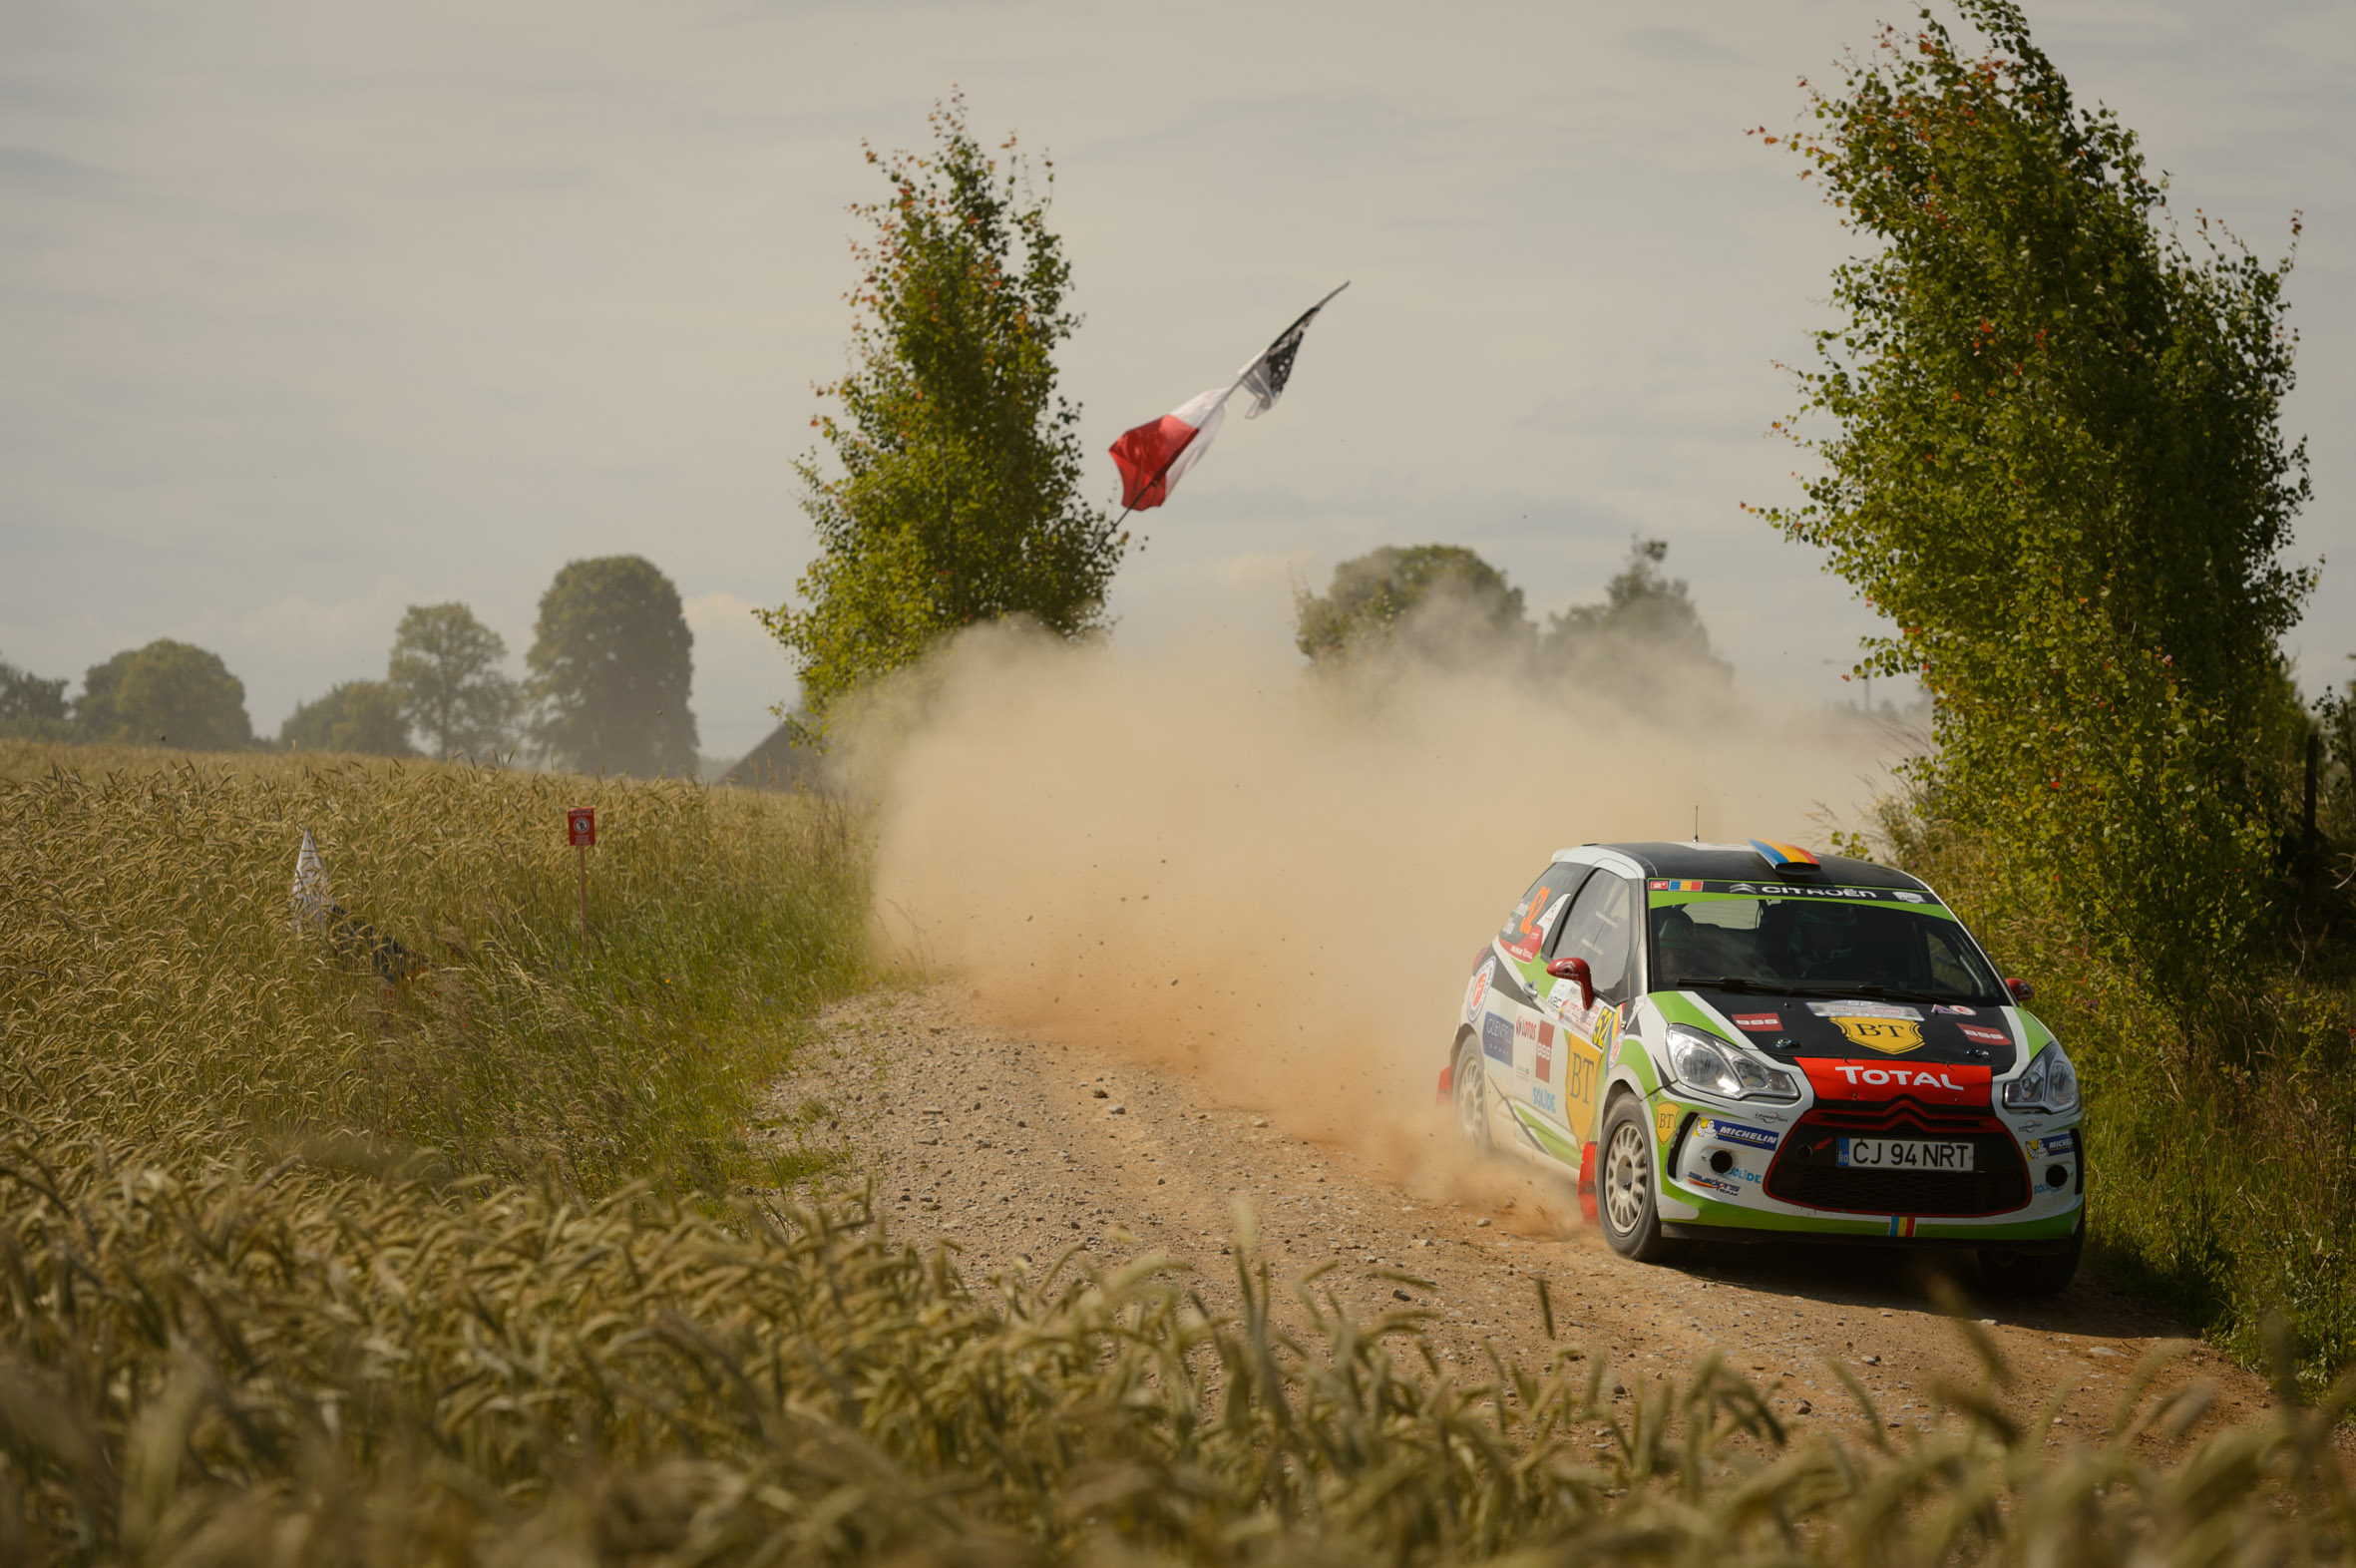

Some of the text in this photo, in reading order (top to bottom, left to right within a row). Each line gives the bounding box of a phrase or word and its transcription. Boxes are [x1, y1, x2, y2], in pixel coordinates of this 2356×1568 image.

[1762, 886, 1877, 898] CITROËN
[1519, 886, 1551, 934] 52
[1522, 1018, 1537, 1041] LOTOS
[1593, 1007, 1613, 1048] 52
[1856, 1023, 1905, 1038] BT
[1537, 1042, 1551, 1061] BSS
[1570, 1052, 1594, 1104] BT
[1834, 1066, 1964, 1091] TOTAL
[1659, 1113, 1675, 1129] BT
[1720, 1126, 1778, 1145] MICHELIN
[2049, 1138, 2075, 1149] MICHE
[1838, 1153, 1849, 1164] RO
[1853, 1143, 1969, 1167] CJ 94 NRT
